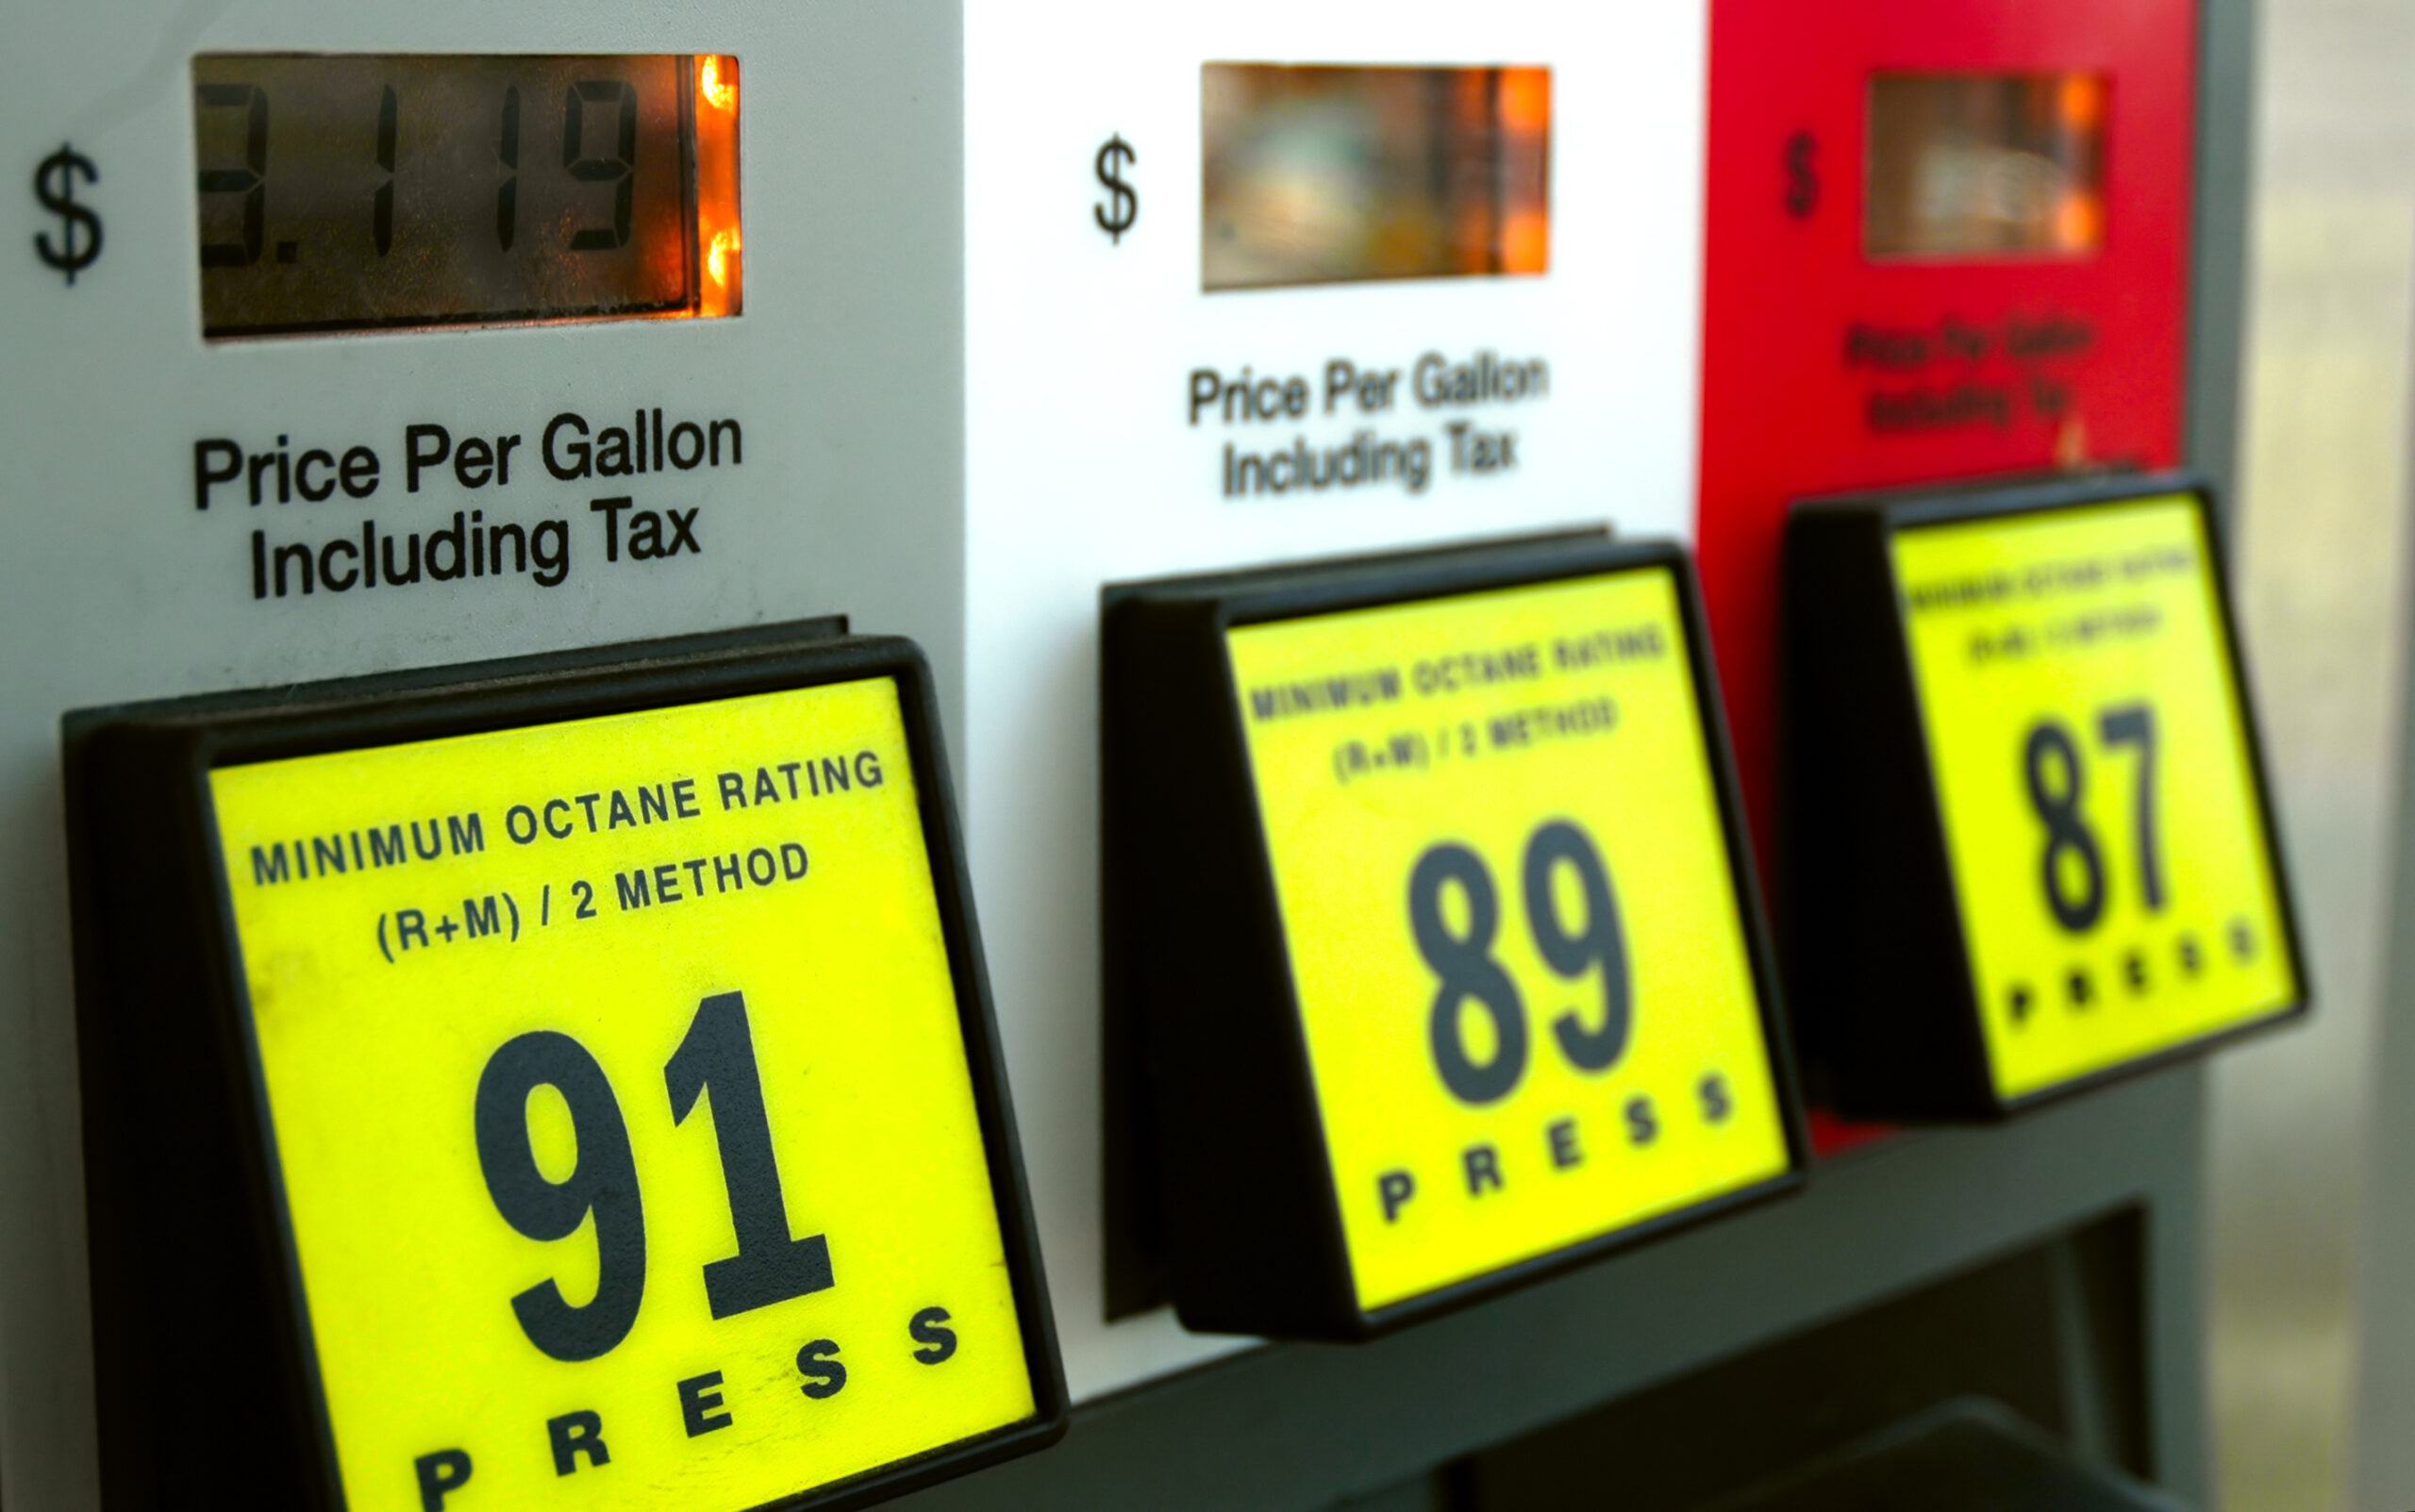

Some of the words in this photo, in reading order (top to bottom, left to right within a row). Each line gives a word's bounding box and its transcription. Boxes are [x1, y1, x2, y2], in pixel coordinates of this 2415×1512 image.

[32, 141, 105, 288] $
[1094, 132, 1139, 246] $
[1189, 366, 1309, 426] Price
[1323, 358, 1402, 414] Per
[1412, 350, 1548, 409] Gallon
[194, 435, 381, 510] Price
[406, 423, 521, 493] Per
[541, 408, 742, 482] Gallon
[1224, 433, 1432, 498] Including
[1445, 419, 1516, 474] Tax
[252, 509, 571, 599] Including
[591, 497, 702, 563] Tax
[251, 812, 485, 887] MINIMUM
[505, 778, 701, 846] OCTANE
[717, 751, 884, 811] RATING
[2022, 700, 2170, 934] 87
[377, 892, 521, 963] (R+M)
[541, 885, 551, 926] /
[570, 880, 596, 921] 2
[616, 842, 808, 911] METHOD
[1406, 817, 1634, 1109] 89
[475, 990, 835, 1363] 91
